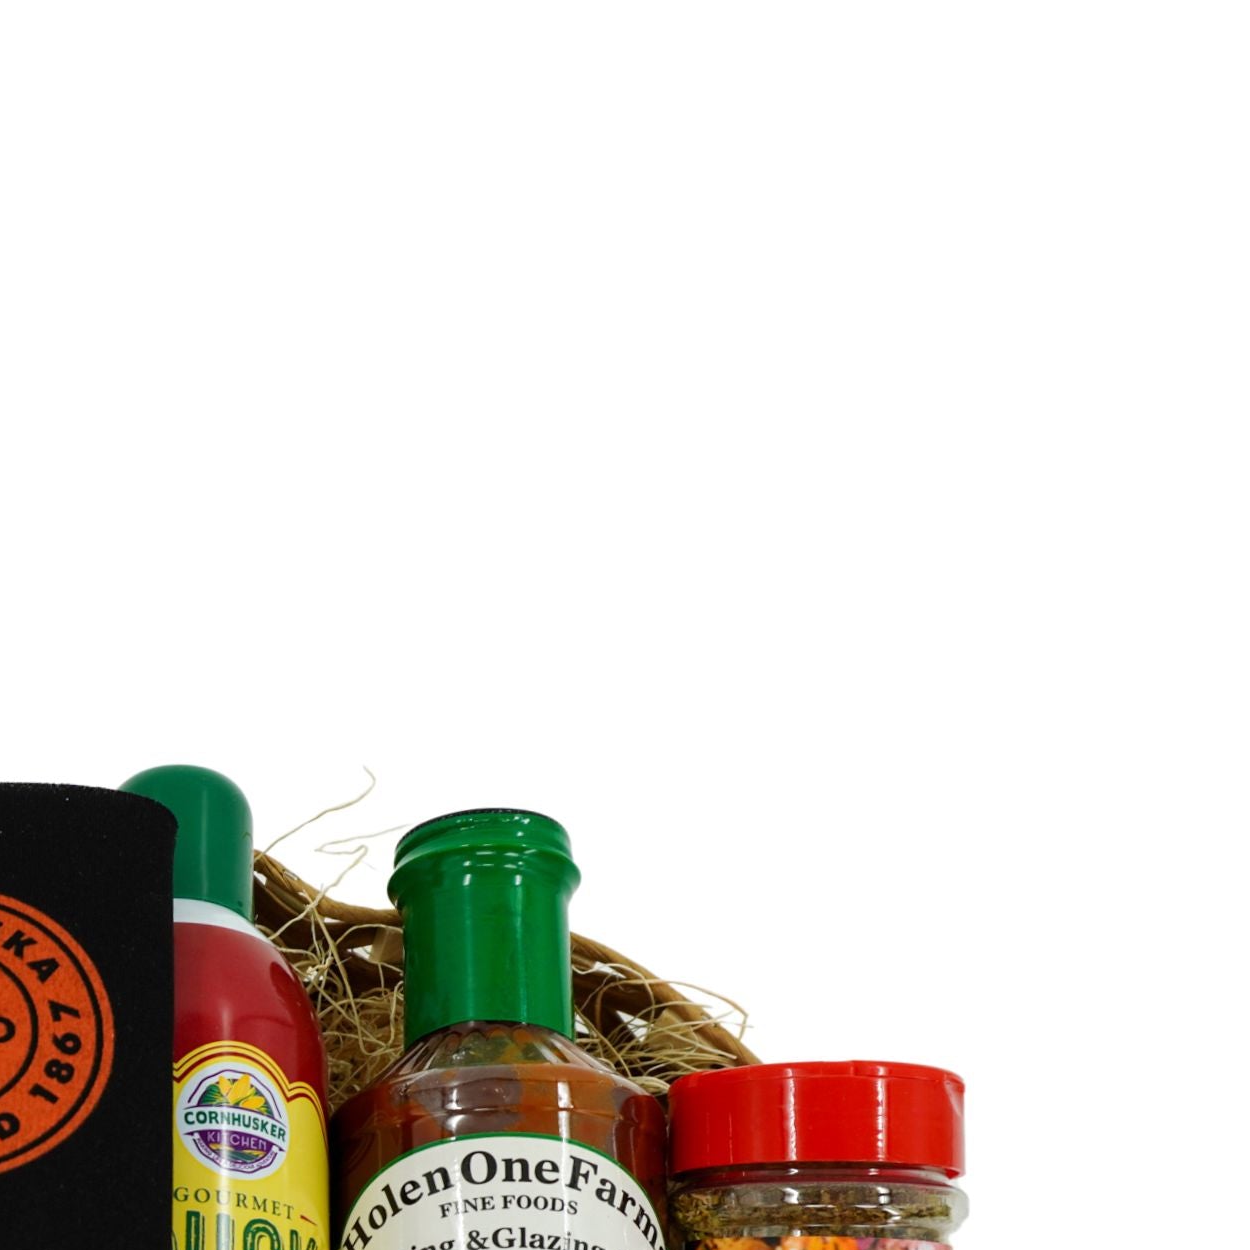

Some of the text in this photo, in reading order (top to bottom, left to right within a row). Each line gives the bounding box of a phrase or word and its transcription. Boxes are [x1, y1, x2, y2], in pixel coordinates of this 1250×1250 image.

[28, 999, 83, 1105] 1867
[184, 1110, 286, 1143] CORNHUSKER
[207, 1131, 267, 1150] KICHEN
[173, 1187, 295, 1220] GOURMET
[438, 1194, 579, 1219] FINE FOODS
